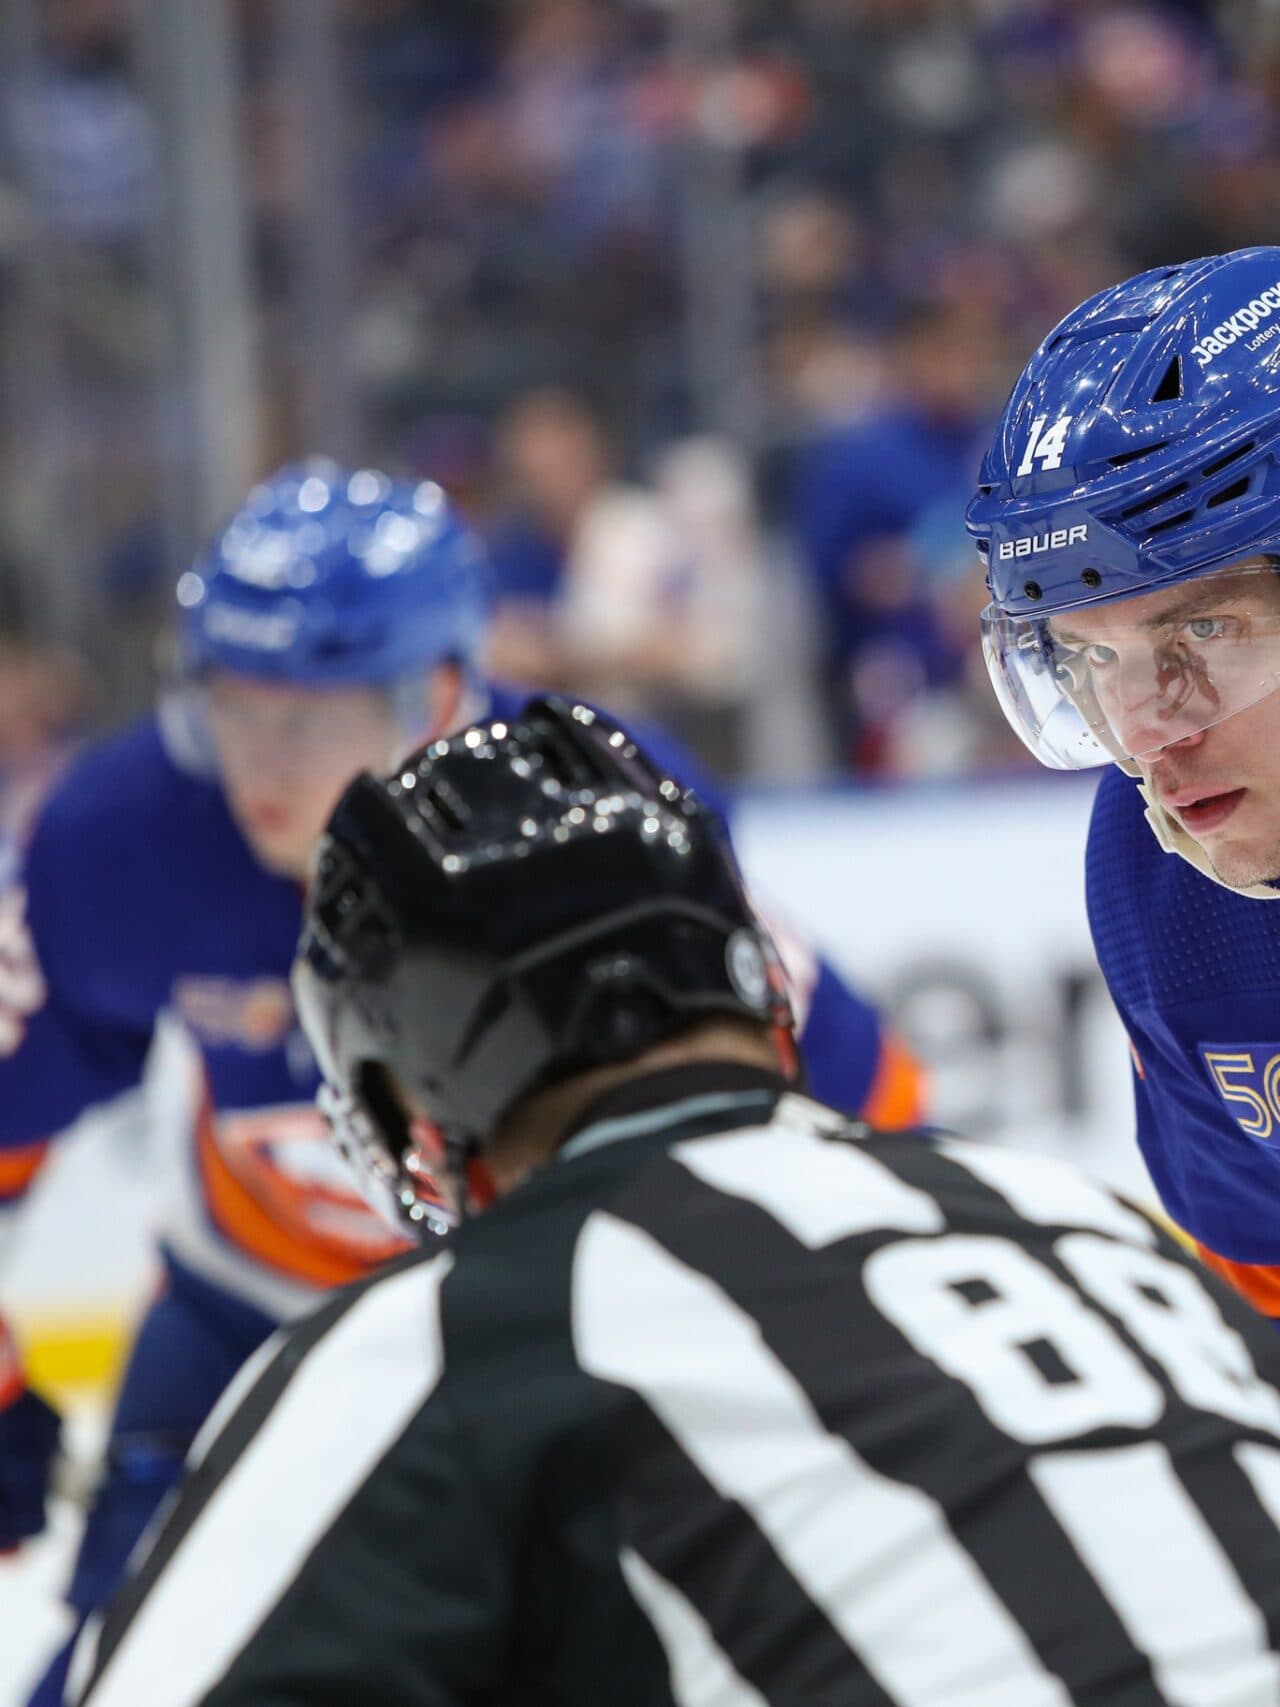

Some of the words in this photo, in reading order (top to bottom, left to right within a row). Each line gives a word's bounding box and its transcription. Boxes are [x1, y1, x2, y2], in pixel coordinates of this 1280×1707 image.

[1244, 322, 1280, 352] Lottery
[1017, 416, 1073, 477] 14
[1000, 524, 1088, 560] BAUER
